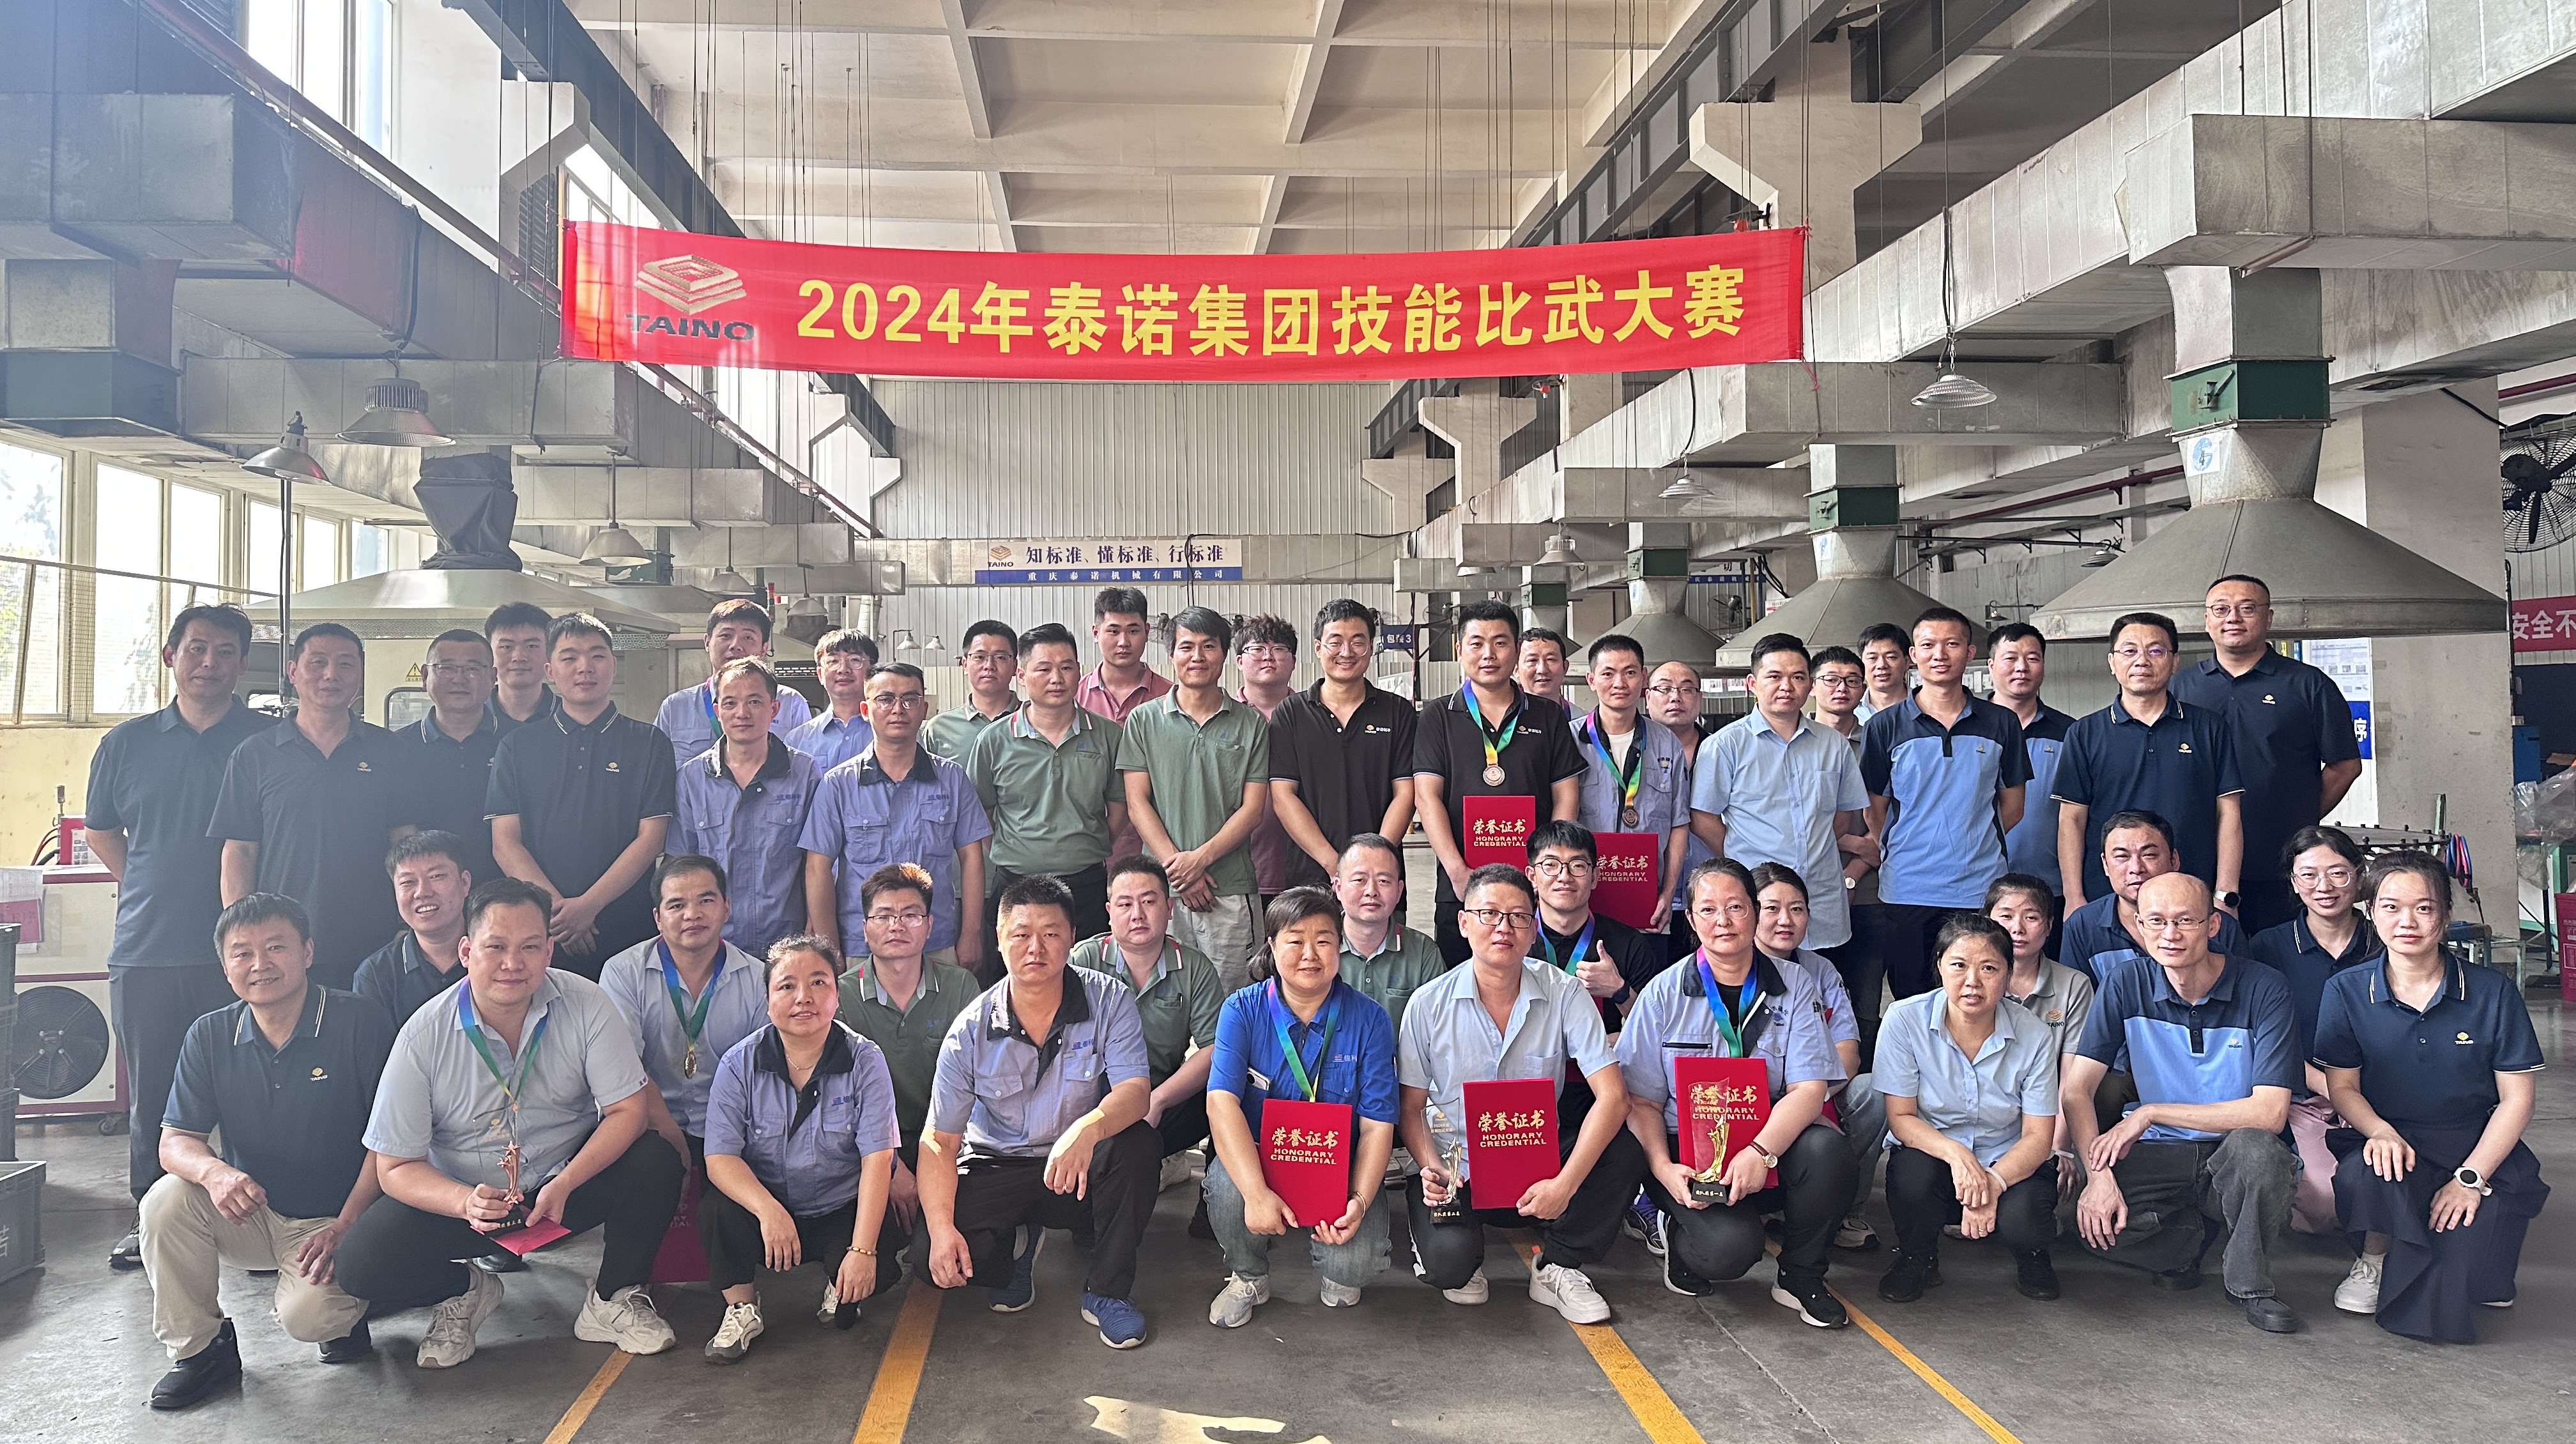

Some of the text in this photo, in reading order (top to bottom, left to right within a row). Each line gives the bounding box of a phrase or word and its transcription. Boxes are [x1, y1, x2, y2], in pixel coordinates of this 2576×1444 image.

[797, 263, 1745, 357] 2024年泰诺集团技能比武大赛
[625, 313, 755, 341] TAINO
[1027, 569, 1223, 581] 重庆泰诺机械有限公司
[2512, 609, 2576, 640] 安全不
[1473, 818, 1526, 835] 荣誉证书
[1597, 854, 1649, 870] 荣誉证书
[1478, 1109, 1545, 1133] 荣誉证书
[1271, 1126, 1339, 1149] 荣誉证书
[1480, 1138, 1547, 1148] CREDENTIAL
[1482, 1132, 1543, 1141] HONORARY
[1270, 1154, 1337, 1165] CREDENTIAL
[1274, 1148, 1334, 1158] HONORARY
